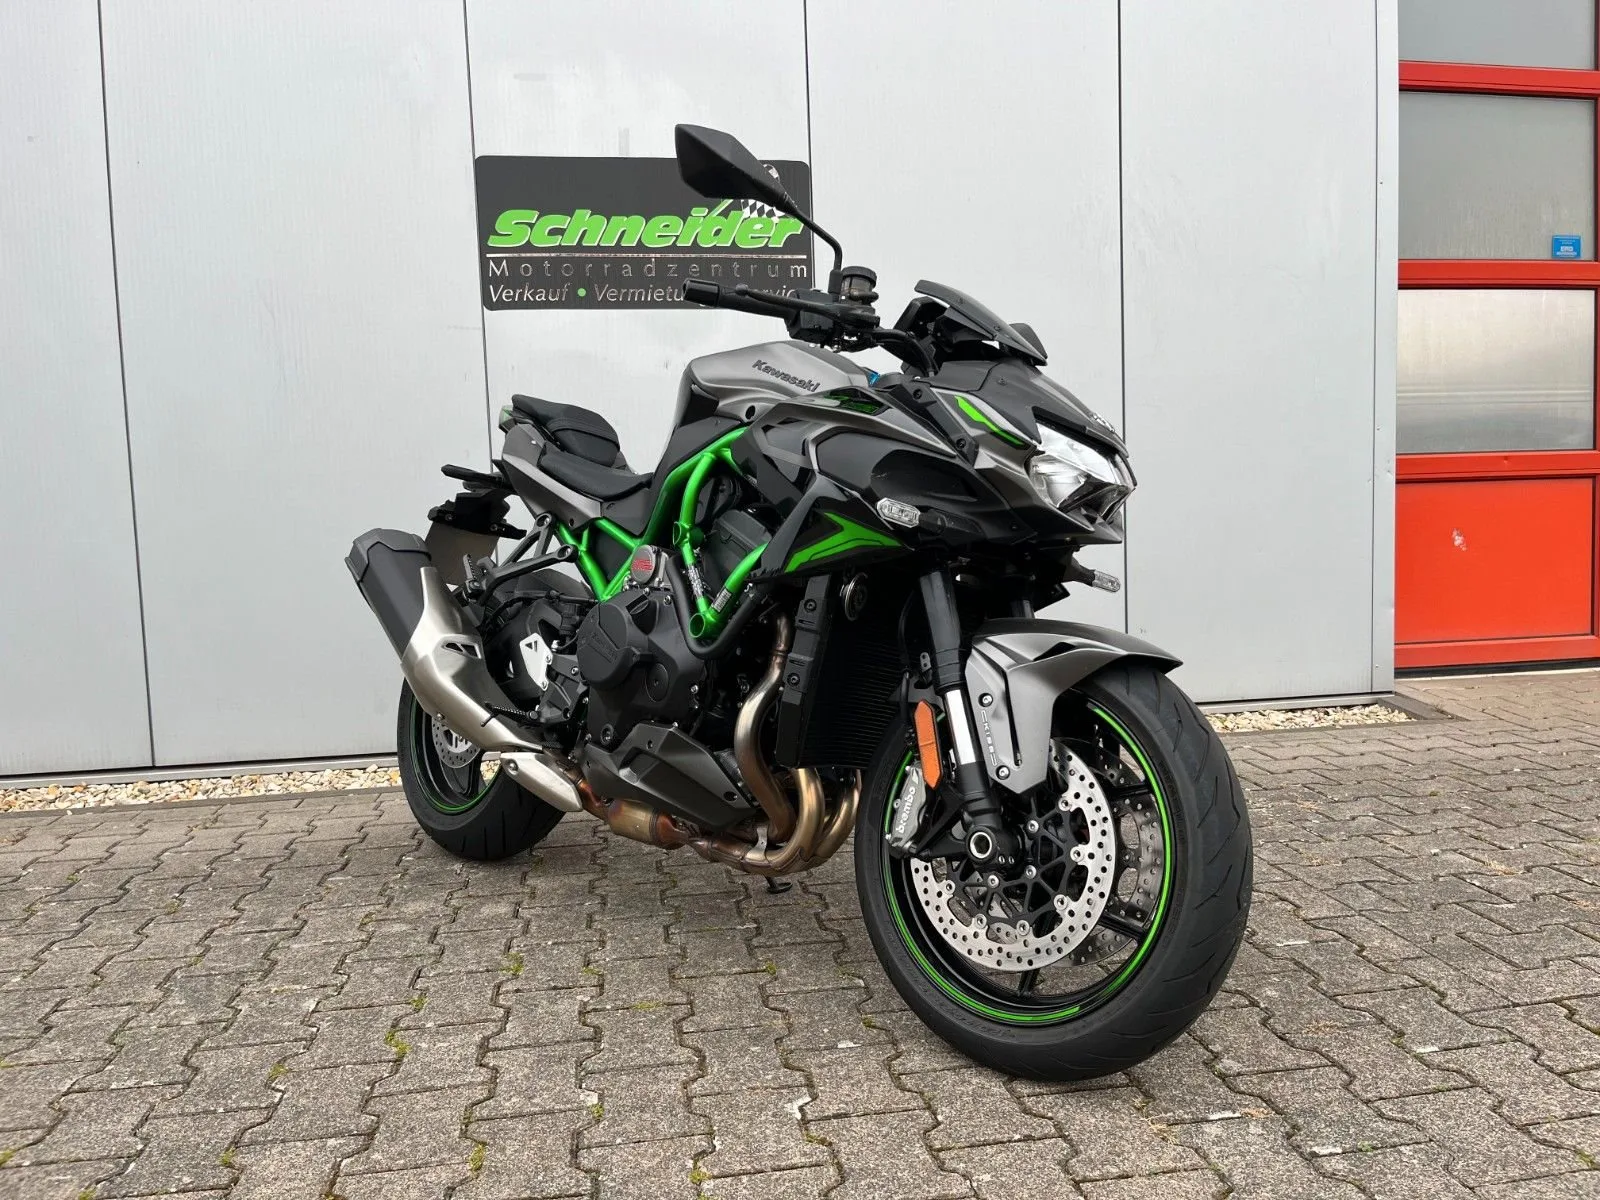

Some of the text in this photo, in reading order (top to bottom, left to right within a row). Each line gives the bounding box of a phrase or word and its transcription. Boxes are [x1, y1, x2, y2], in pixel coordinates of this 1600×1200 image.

[487, 206, 804, 248] Schneider
[488, 258, 808, 279] Motorradzentrum
[489, 282, 573, 303] Verkauf
[595, 283, 685, 303] Vermietu
[751, 359, 821, 393] Kawasaki
[895, 786, 917, 834] brembo
